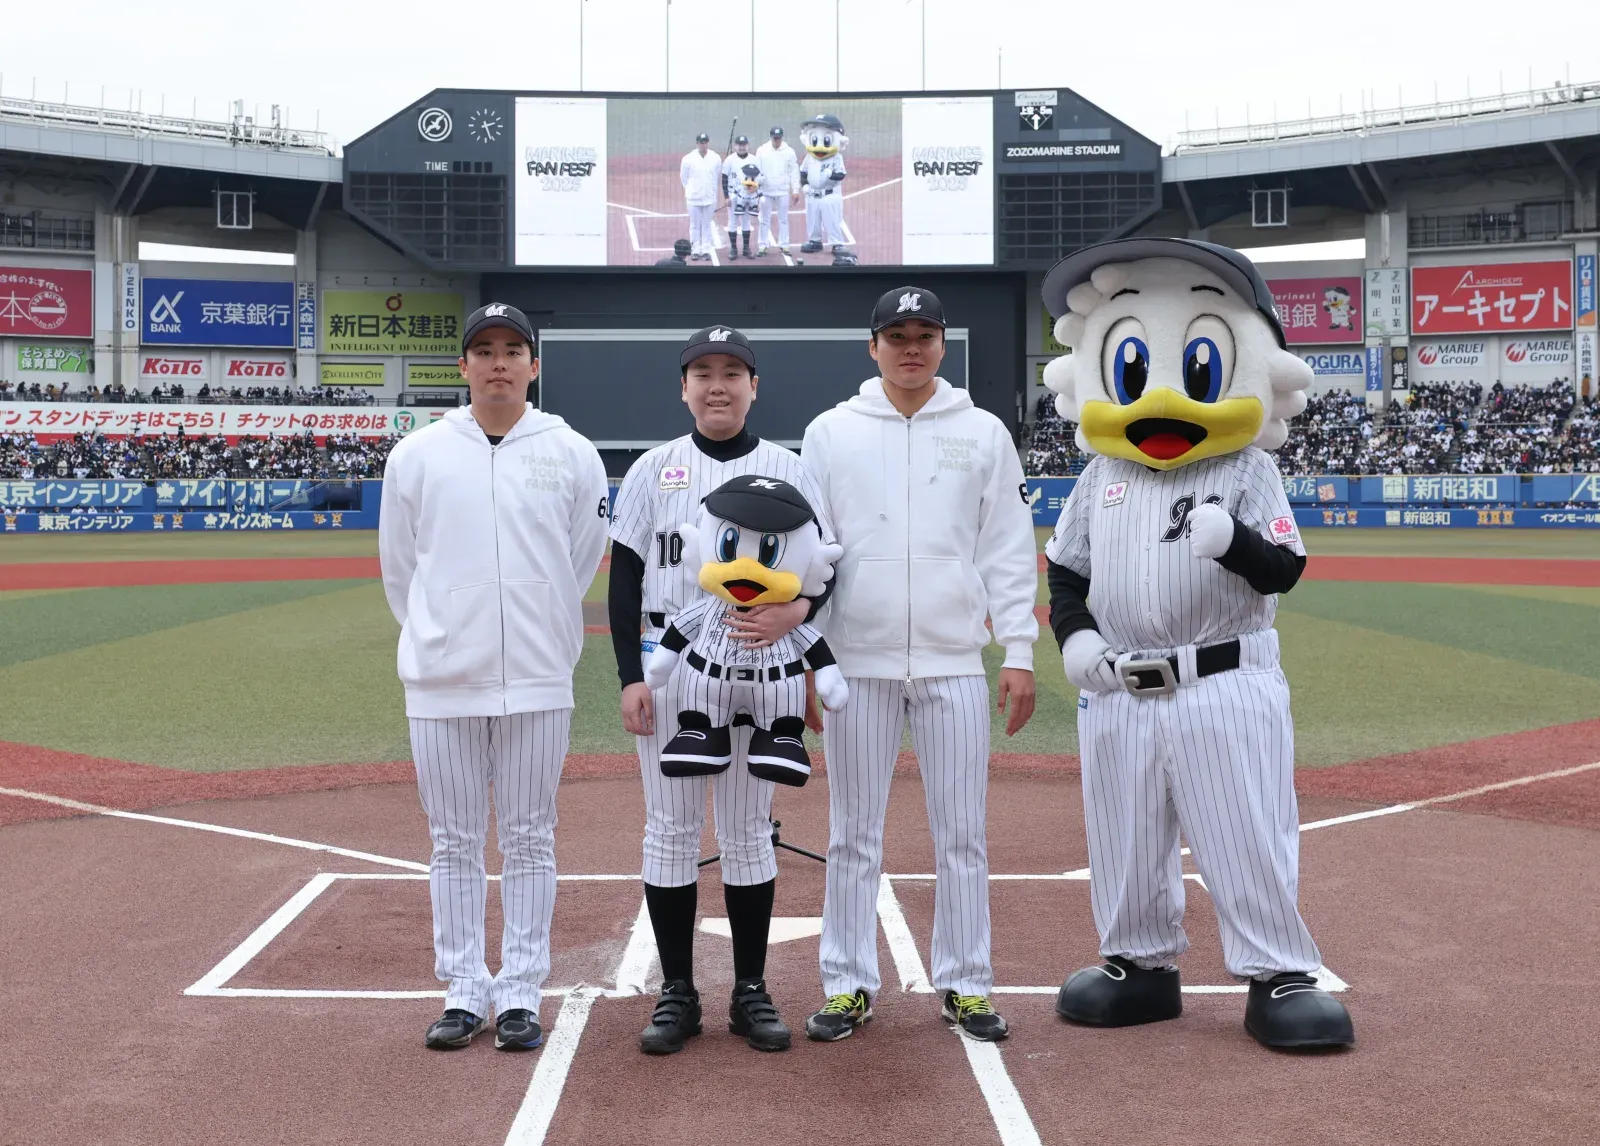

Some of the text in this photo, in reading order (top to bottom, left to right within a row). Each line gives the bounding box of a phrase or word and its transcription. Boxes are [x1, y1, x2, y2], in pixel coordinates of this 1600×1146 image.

[524, 146, 597, 162] MARINES
[912, 146, 984, 161] MARINES
[1006, 145, 1121, 157] ZOZOMARINE STADIUM
[424, 161, 448, 171] TIME
[527, 161, 597, 177] FAN FEST
[914, 161, 983, 177] FAN FEST
[540, 177, 582, 192] 2025
[125, 276, 136, 329] ZENKO
[896, 291, 922, 313] M
[1272, 292, 1316, 301] arines!
[1391, 284, 1402, 328] 吉田工業
[1416, 286, 1569, 326] アーキセプト
[200, 301, 291, 326] 京葉銀行
[150, 323, 182, 333] BANK
[299, 300, 314, 348] 大森工業
[329, 313, 458, 339] 新日本建設
[21, 346, 65, 359] そらまめ
[330, 343, 457, 352] INTELLIGENT DEVELOPER
[1437, 343, 1484, 354] MARUEI
[1305, 354, 1363, 369] OGURA
[1441, 354, 1478, 365] Group
[1530, 351, 1569, 362] Group
[22, 358, 57, 370] 保育園
[932, 436, 979, 449] THANK
[942, 448, 970, 459] YOU
[520, 455, 570, 468] THANK
[938, 459, 972, 472] FANS
[529, 466, 559, 480] YOU
[525, 478, 560, 492] FANS
[1413, 476, 1498, 500] 新昭和
[38, 514, 134, 531] 東京インテリア
[219, 512, 294, 529] アインズホーム
[1403, 511, 1451, 525] 新昭和
